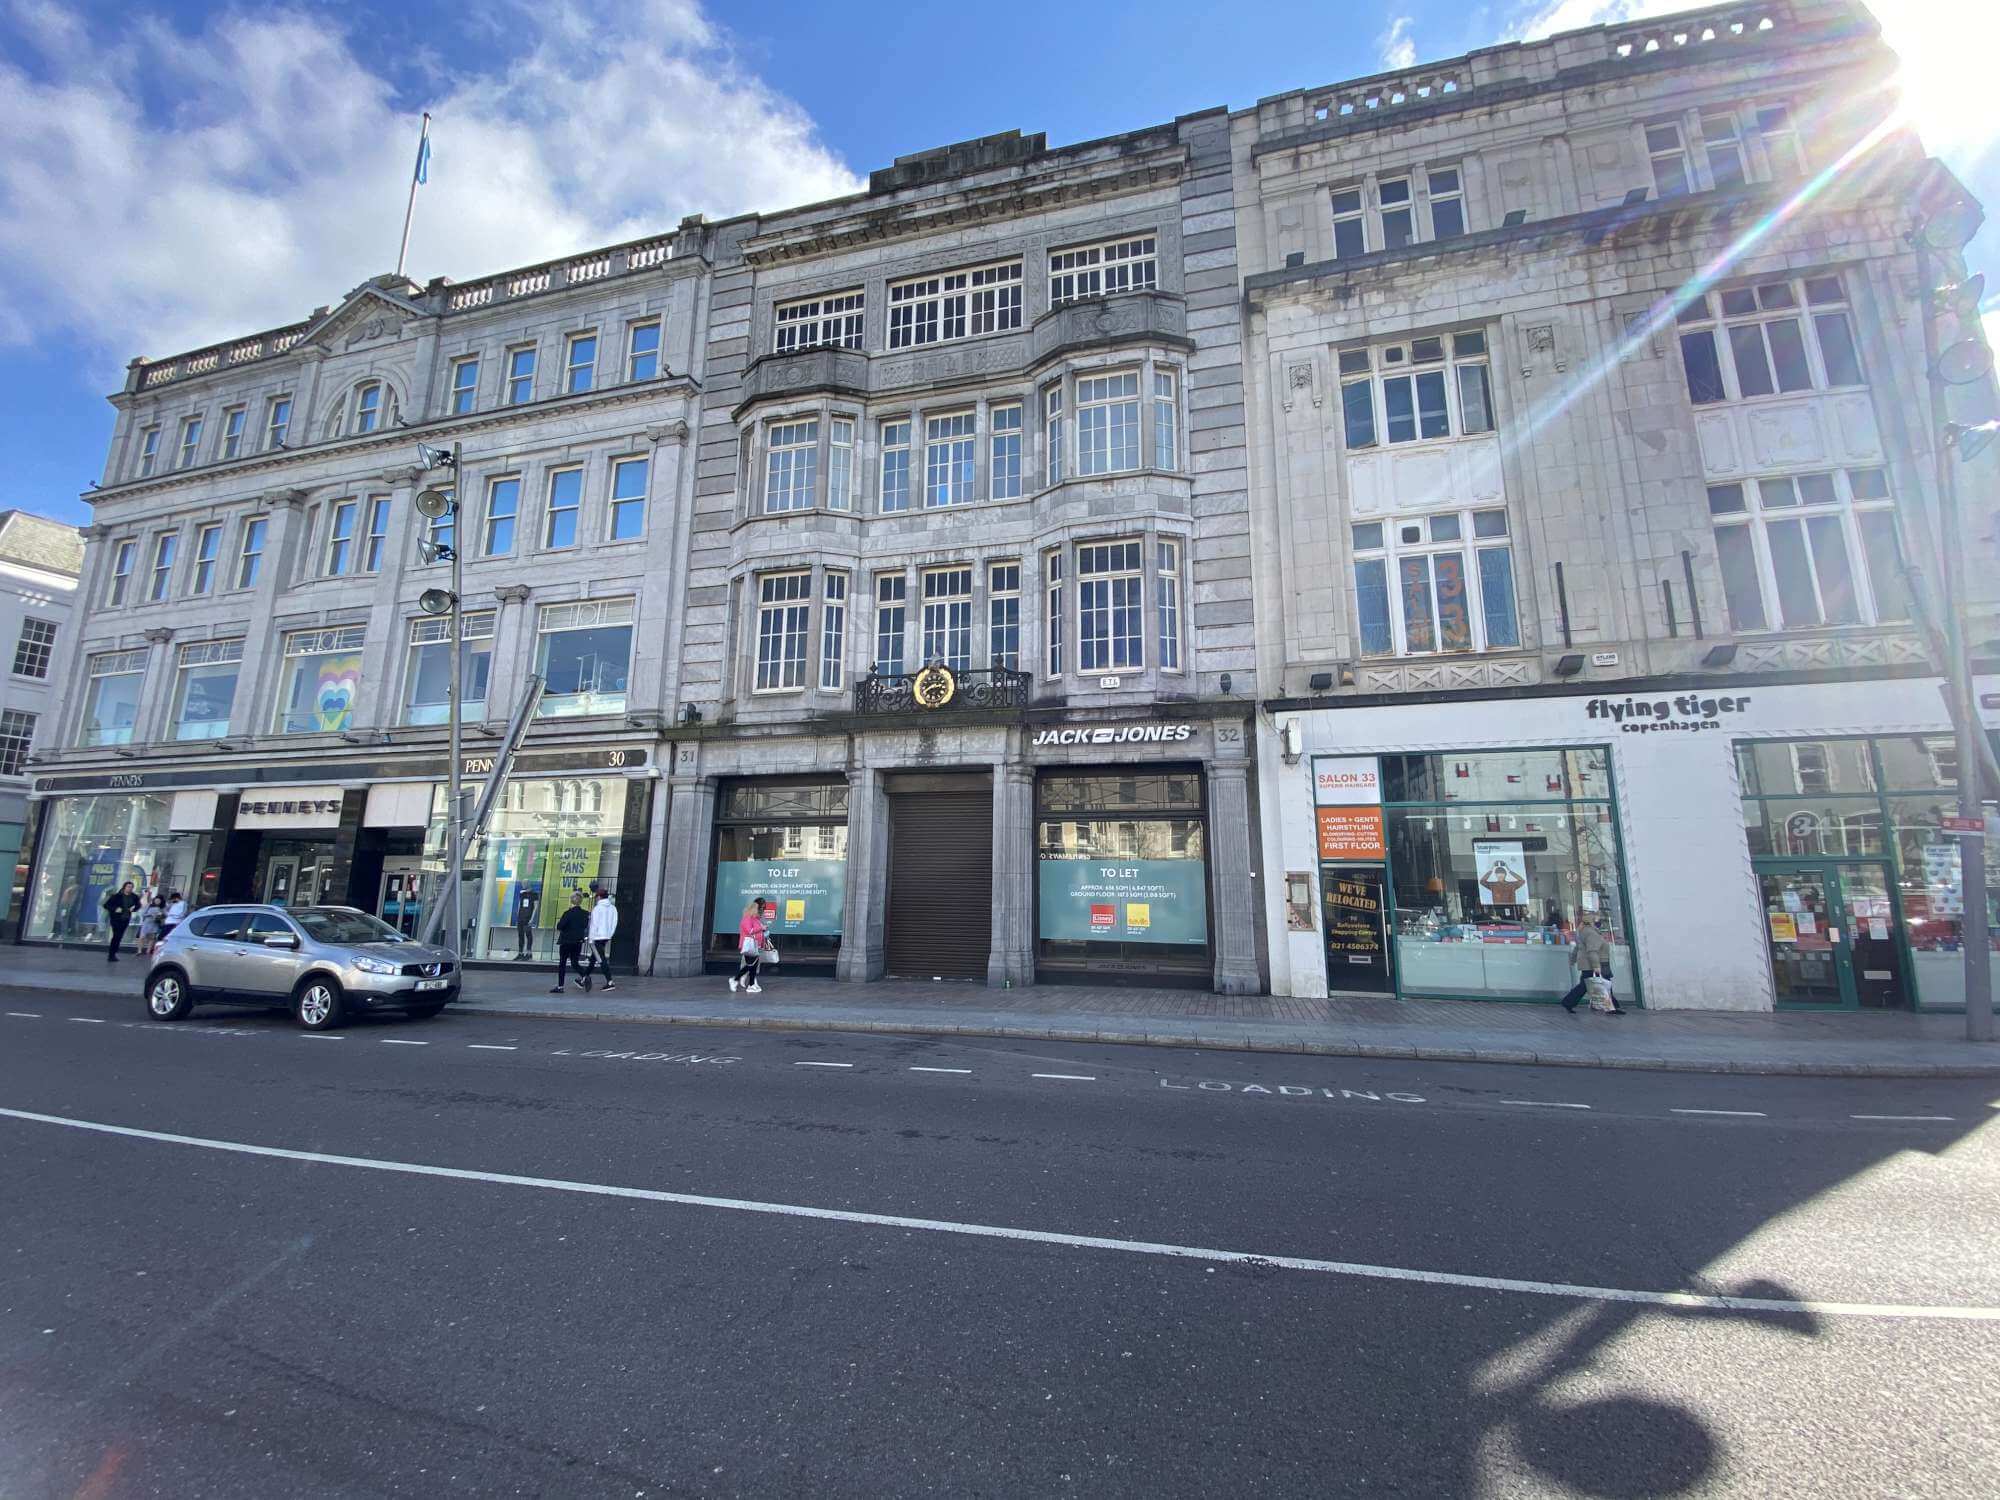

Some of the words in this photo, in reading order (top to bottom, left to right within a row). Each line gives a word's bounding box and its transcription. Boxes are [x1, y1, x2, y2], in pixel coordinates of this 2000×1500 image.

[1586, 697, 1670, 722] flying
[1674, 694, 1751, 718] tiger
[1622, 720, 1720, 734] copenhagen
[1032, 729, 1094, 746] JACK
[1114, 725, 1191, 742] JONES
[1218, 728, 1240, 742] 32
[608, 751, 625, 767] 30
[680, 750, 695, 762] 31
[110, 774, 143, 788] PENNEYS
[1319, 773, 1357, 783] SALON
[1362, 773, 1375, 782] 33
[240, 799, 340, 815] PENNEYS
[560, 862, 585, 874] FANS
[768, 868, 780, 877] TO
[783, 868, 800, 878] LET
[1100, 868, 1116, 878] TO
[1119, 868, 1139, 878] LET
[1339, 882, 1367, 896] WE'VE
[1326, 892, 1376, 910] RELOCATED
[551, 1049, 744, 1065] LOADING
[1160, 1079, 1427, 1103] LOADING
